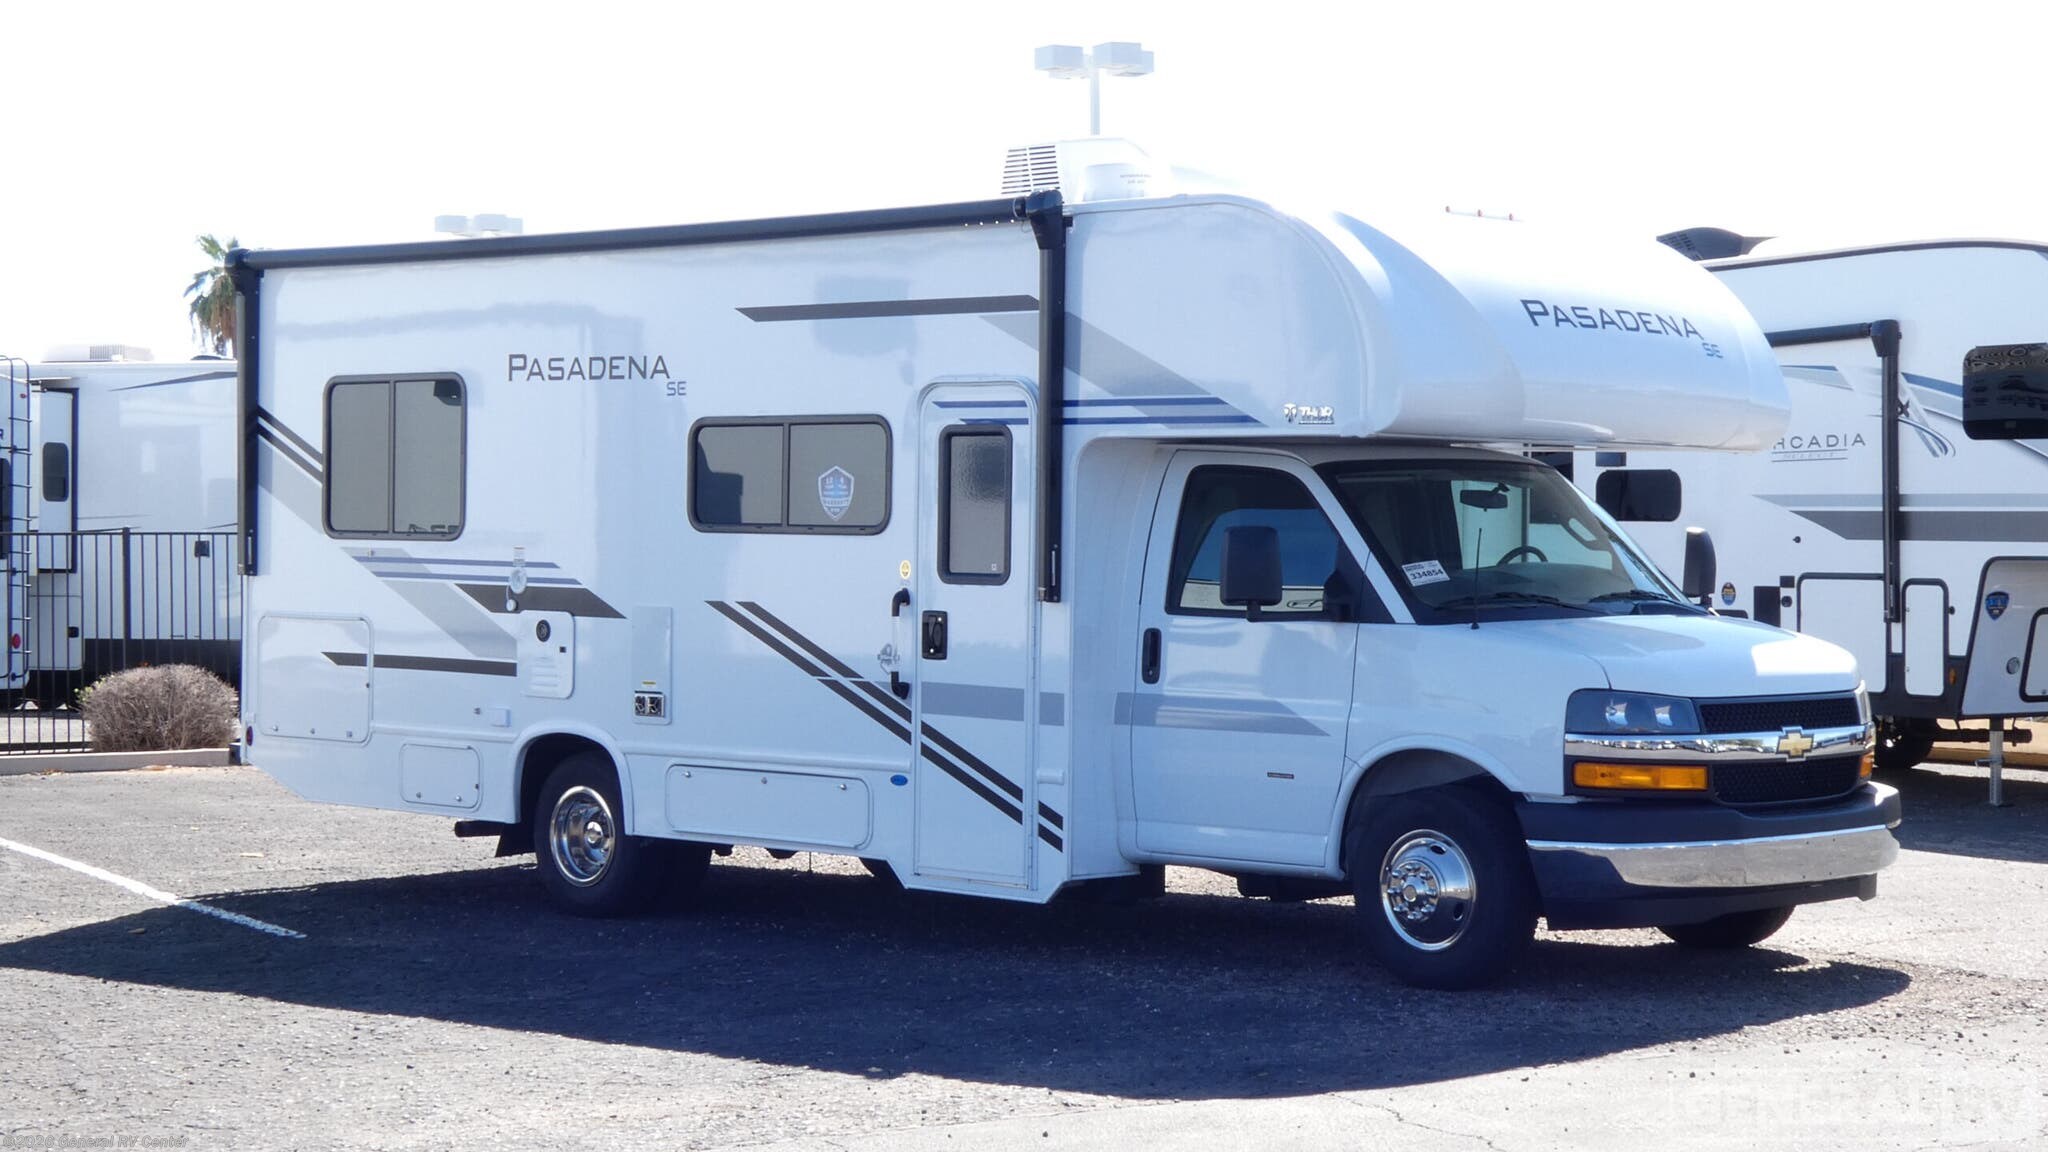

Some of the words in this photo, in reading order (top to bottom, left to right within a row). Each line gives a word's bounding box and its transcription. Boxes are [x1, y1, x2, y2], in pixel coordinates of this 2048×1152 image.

[1519, 298, 1705, 340] PASADENA
[1701, 342, 1724, 359] SE
[508, 353, 671, 382] PASADENA
[666, 381, 687, 396] SE
